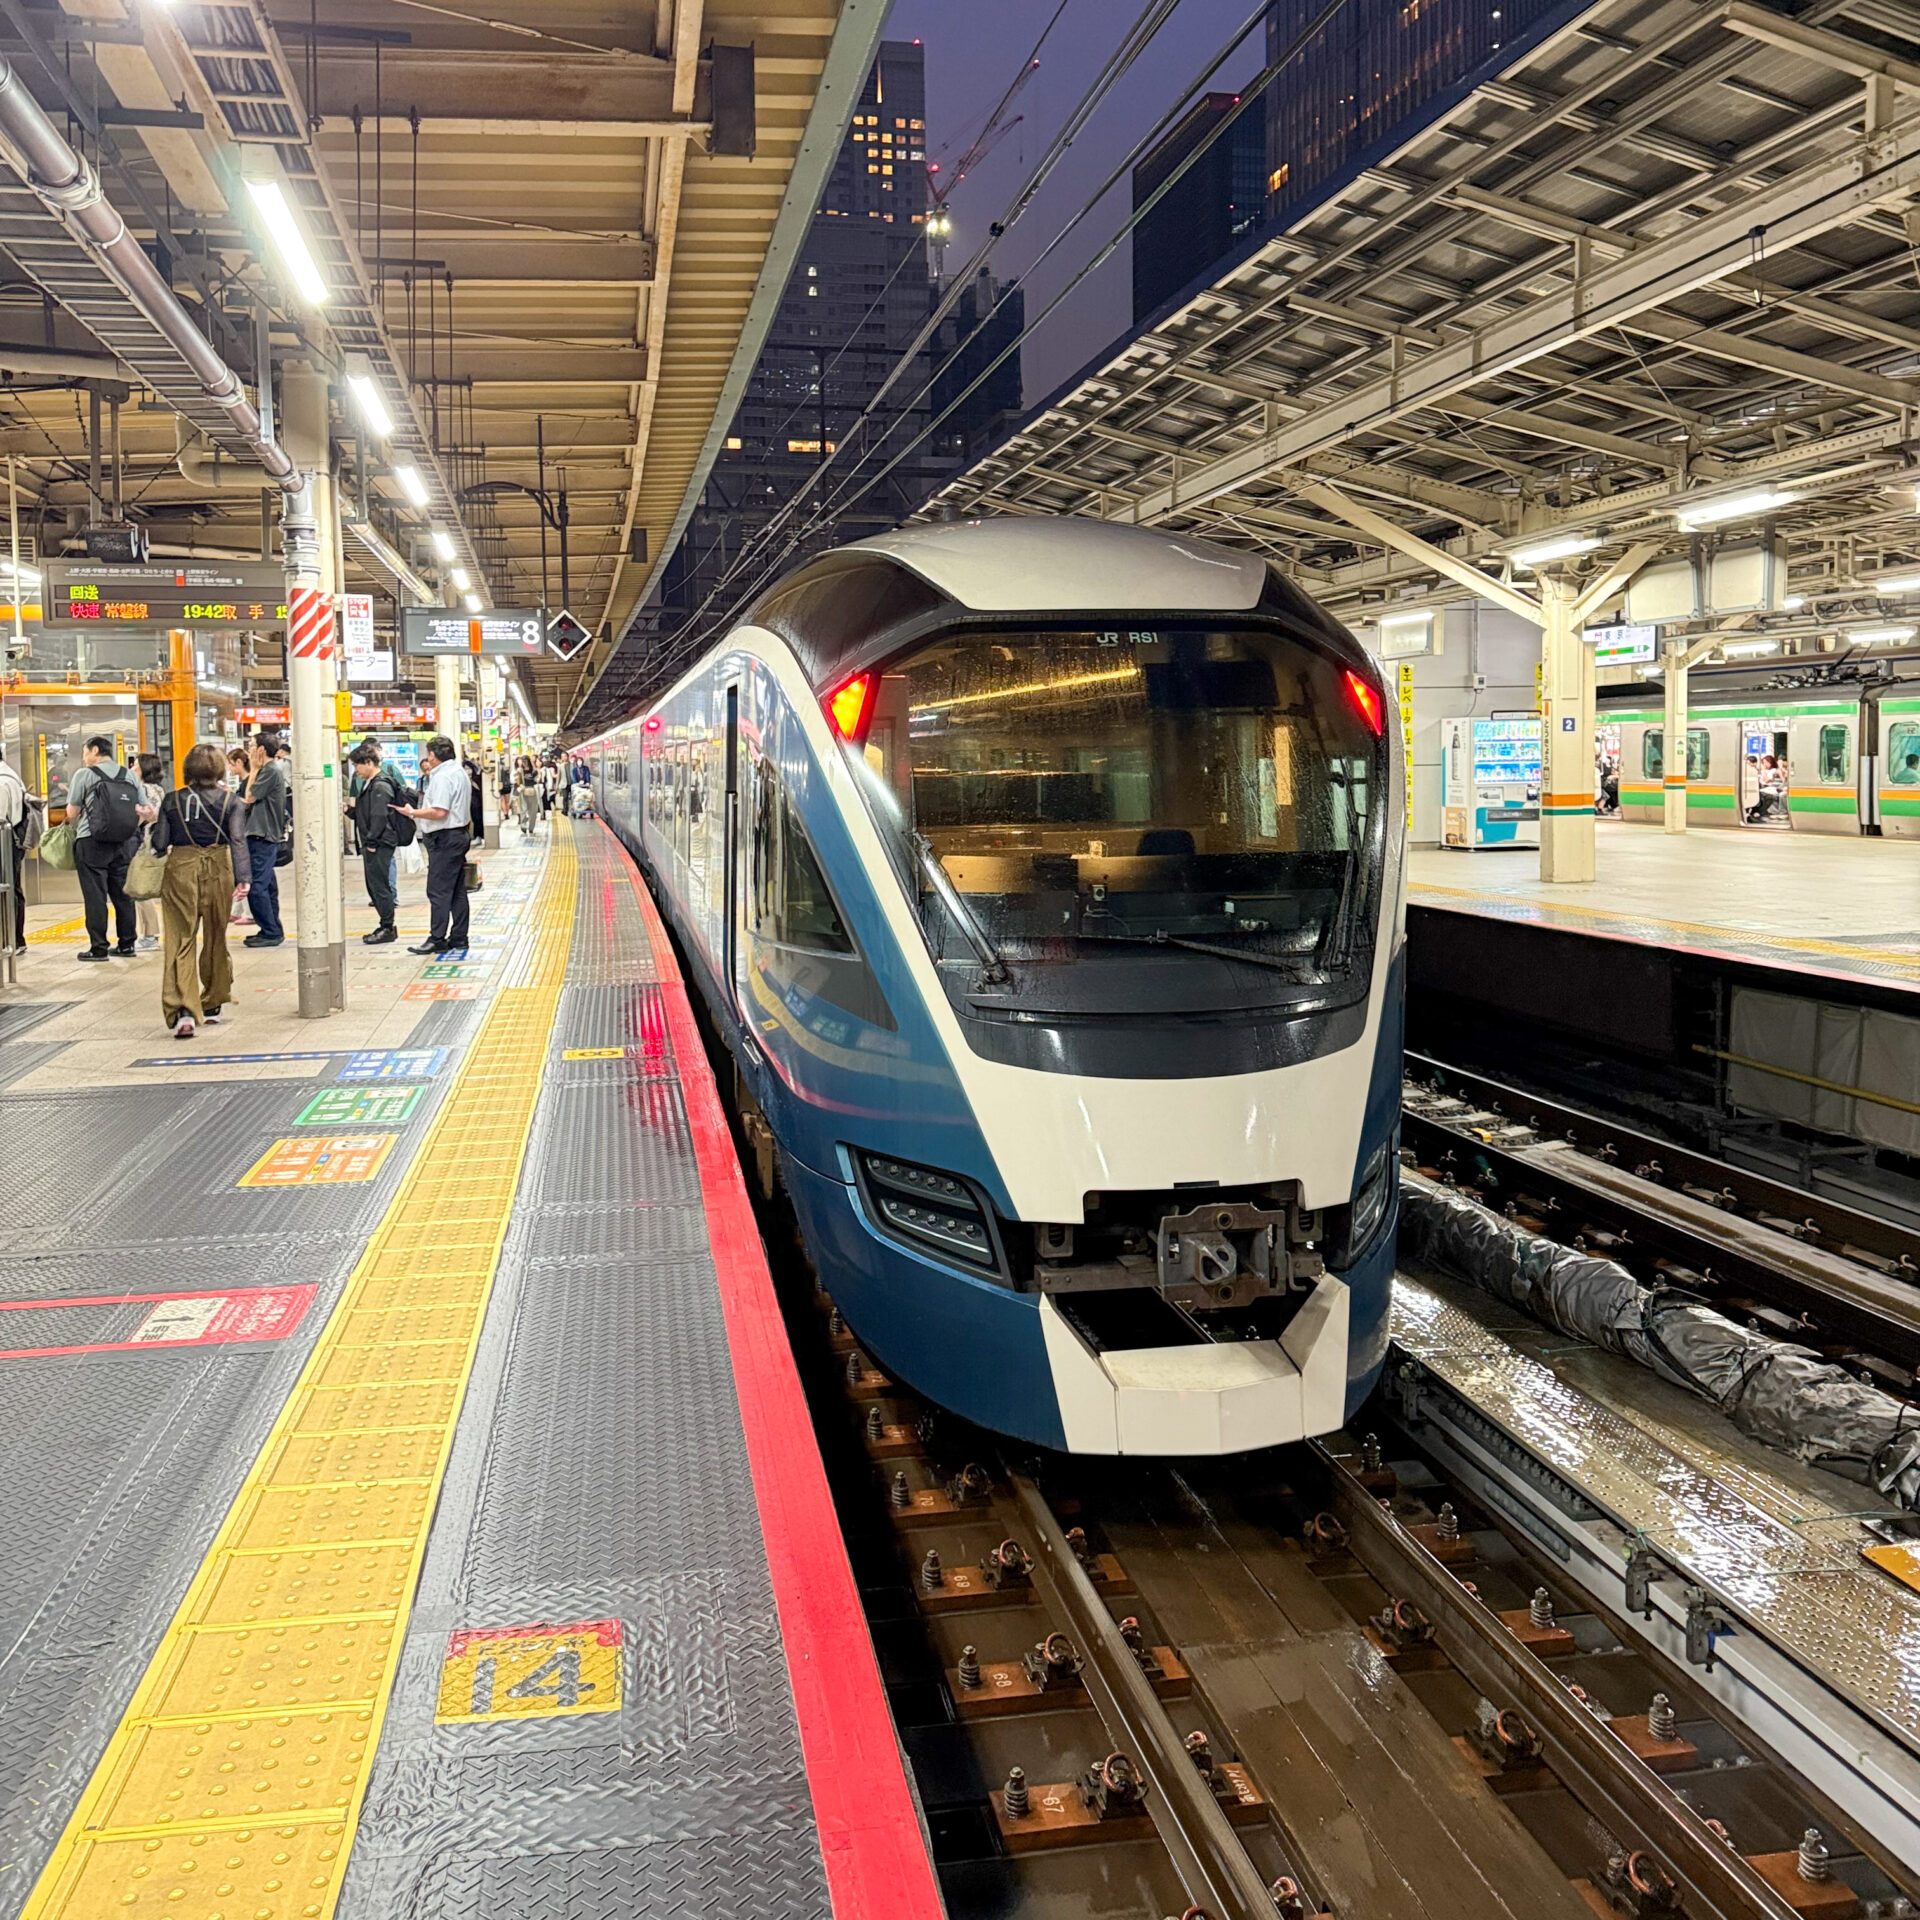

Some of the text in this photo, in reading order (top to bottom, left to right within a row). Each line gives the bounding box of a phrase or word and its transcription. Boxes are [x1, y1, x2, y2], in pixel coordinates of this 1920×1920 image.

[70, 585, 99, 600] 回送
[71, 603, 100, 619] 快速
[183, 604, 224, 619] 19:42
[521, 620, 541, 645] 8
[1096, 632, 1159, 644] JR RS1
[424, 708, 435, 721] 8
[1565, 719, 1573, 730] 2
[470, 1650, 597, 1714] 14
[992, 1673, 1013, 1688] 68
[1042, 1796, 1065, 1813] 67
